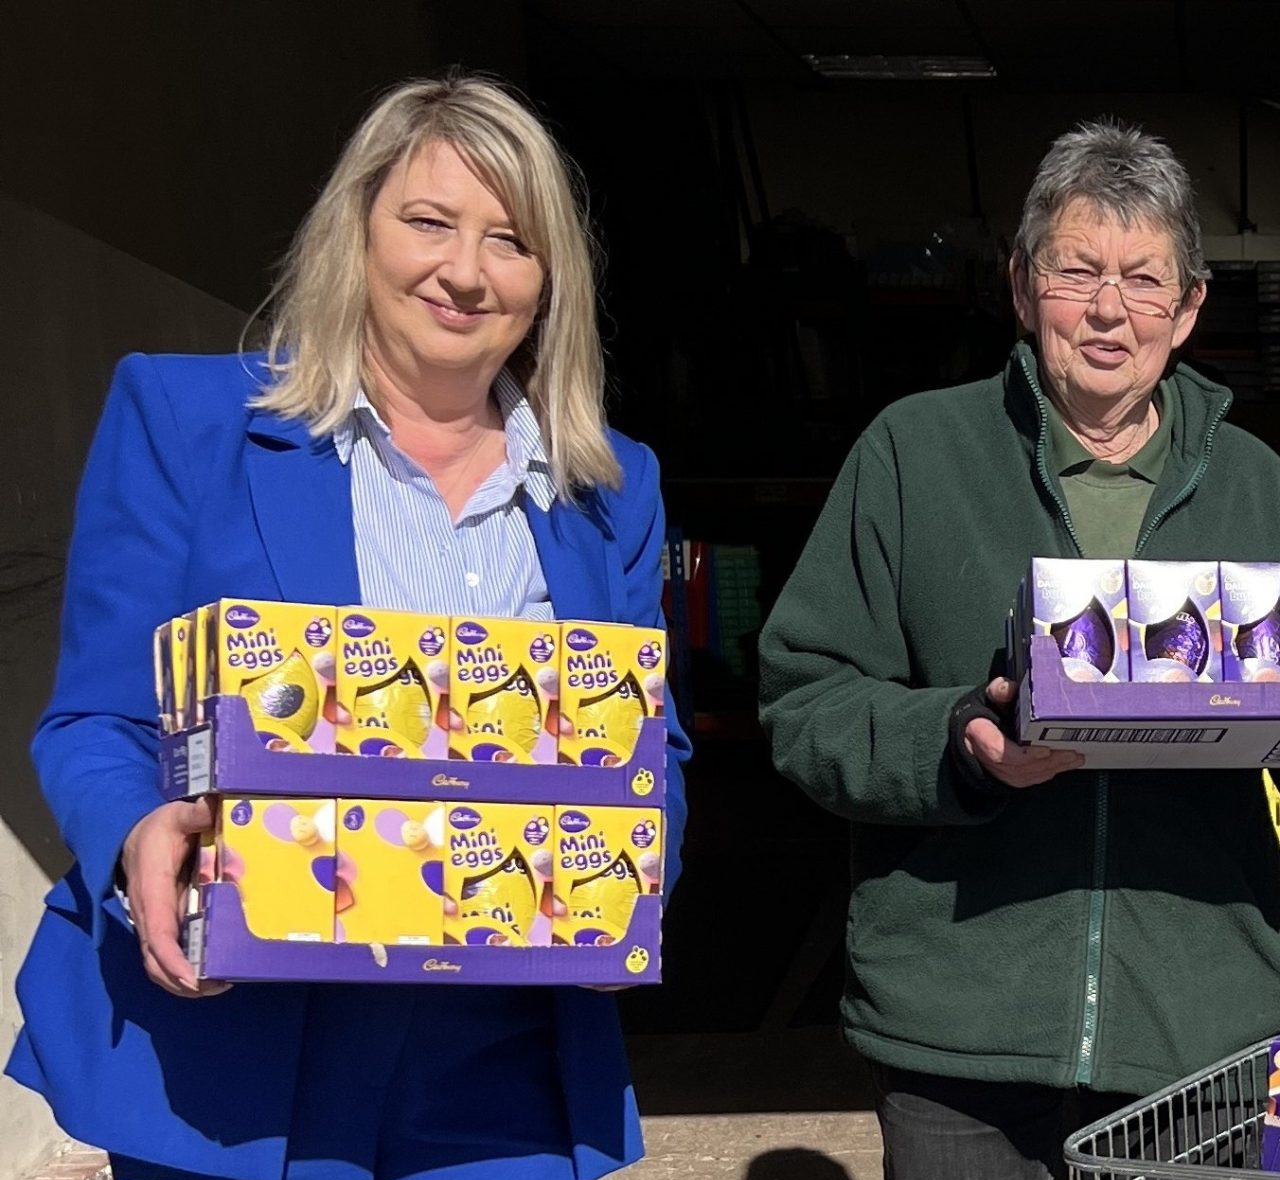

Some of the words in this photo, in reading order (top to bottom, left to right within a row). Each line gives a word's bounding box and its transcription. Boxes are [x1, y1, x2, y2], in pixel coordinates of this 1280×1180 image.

[227, 627, 276, 651] Mini
[344, 637, 391, 660] Mini
[228, 648, 283, 669] eggs
[457, 644, 503, 665] Mini
[567, 650, 612, 672] Mini
[345, 657, 398, 678] eggs
[458, 664, 510, 683] eggs
[568, 669, 618, 689] eggs
[450, 828, 497, 851] Mini
[559, 831, 606, 854] Mini
[451, 847, 504, 867] eggs
[561, 850, 611, 870] eggs
